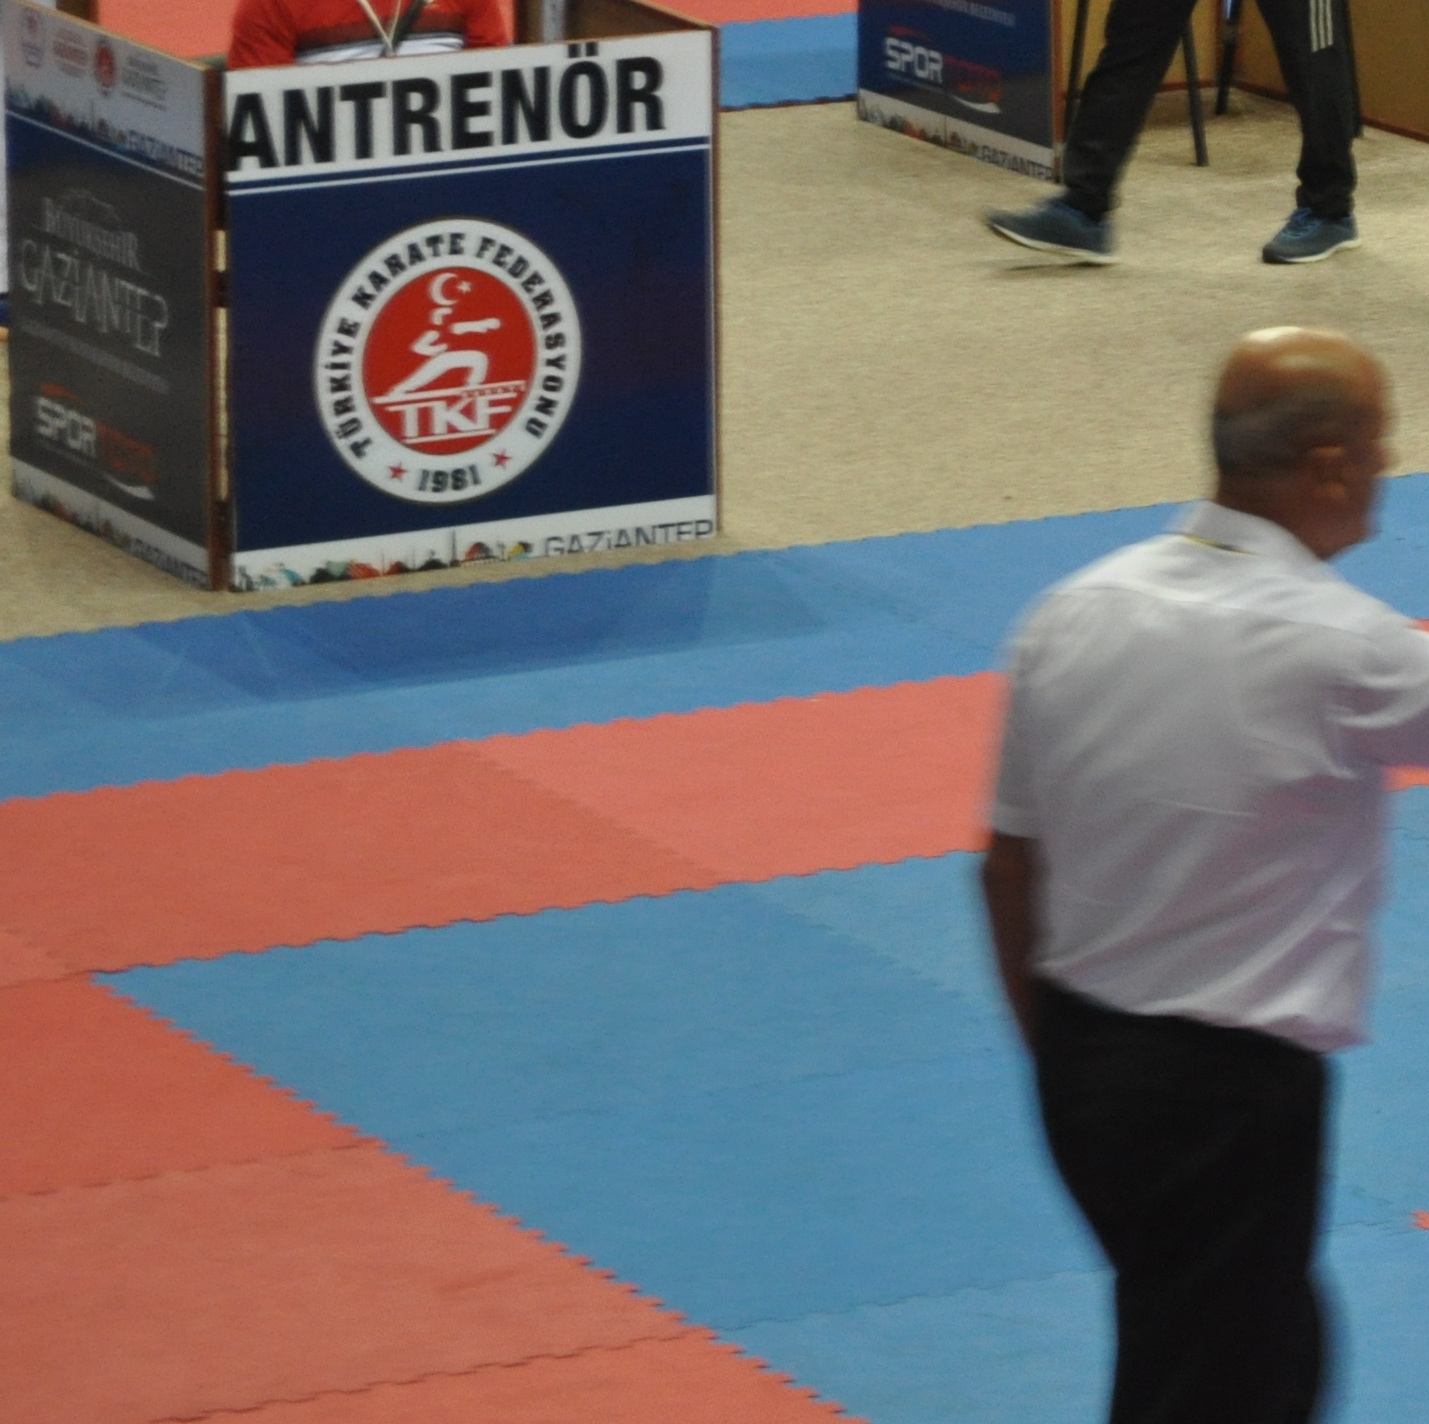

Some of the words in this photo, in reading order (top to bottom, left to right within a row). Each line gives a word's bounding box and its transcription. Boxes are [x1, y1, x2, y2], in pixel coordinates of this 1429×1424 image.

[884, 35, 944, 84] SPOR
[228, 41, 666, 172] ANTRENÖR
[324, 317, 374, 460] TÜRKİYE
[352, 232, 466, 311] KARATE
[475, 235, 568, 439] FEDERASYONU
[386, 391, 520, 439] TKF
[418, 464, 482, 493] 1981
